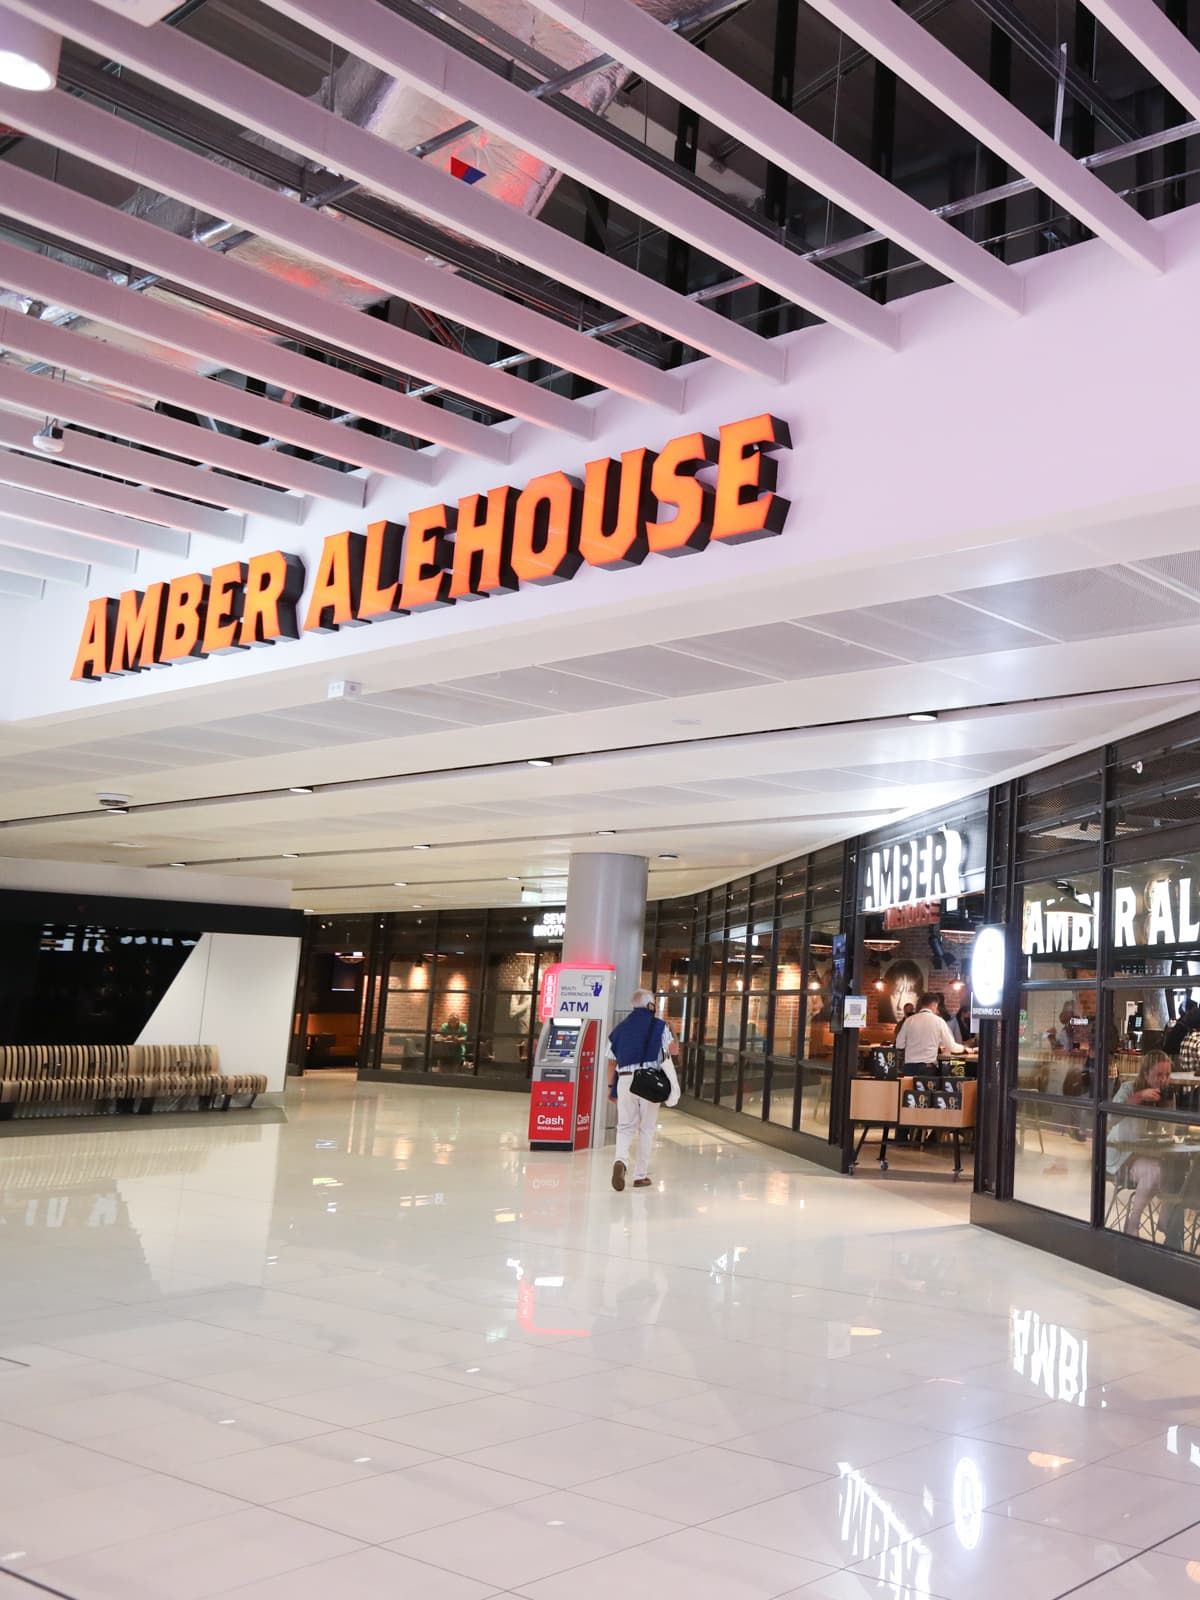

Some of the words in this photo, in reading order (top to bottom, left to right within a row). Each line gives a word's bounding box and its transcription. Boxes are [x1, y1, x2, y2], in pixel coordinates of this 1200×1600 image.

[69, 551, 303, 682] AMBER
[303, 412, 793, 634] ALEHOUSE
[862, 826, 963, 914] AMBER
[560, 1001, 589, 1013] ATM
[537, 1114, 564, 1125] Cash
[577, 1113, 590, 1125] Cash
